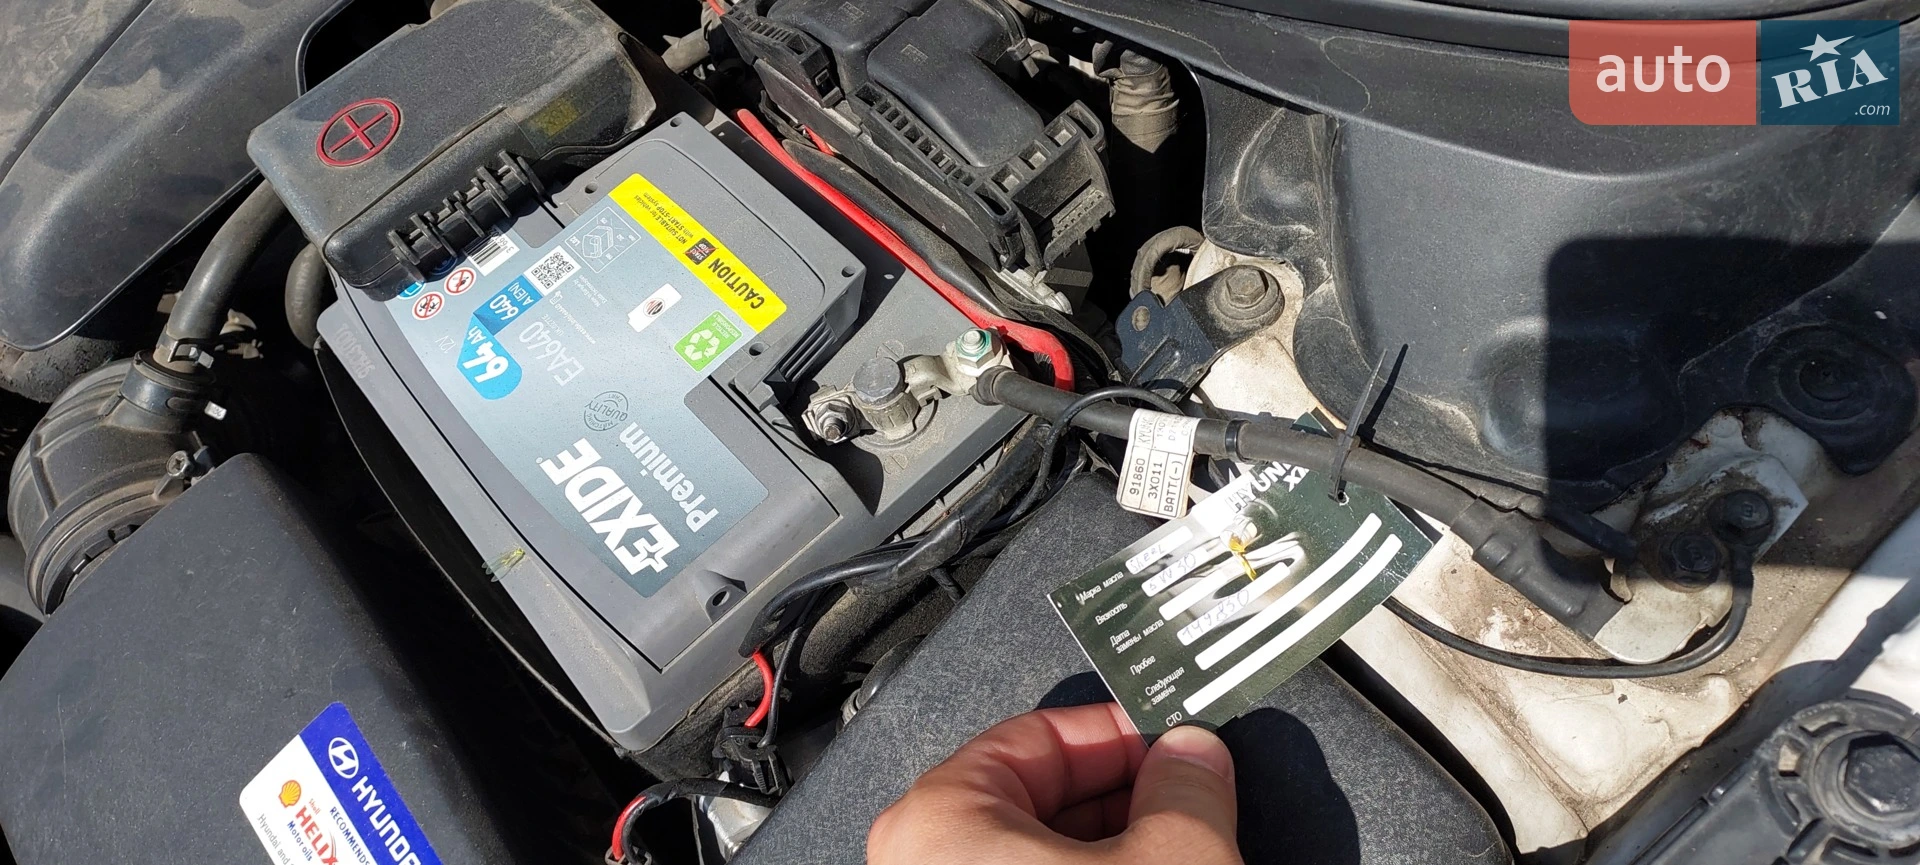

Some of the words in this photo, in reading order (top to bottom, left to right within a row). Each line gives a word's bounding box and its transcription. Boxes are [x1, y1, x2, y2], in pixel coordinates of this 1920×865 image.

[655, 215, 677, 237] SUITABLE
[676, 235, 688, 245] NOT
[707, 257, 765, 309] CAUTION
[489, 293, 519, 321] 640
[435, 325, 457, 354] 12V
[467, 325, 487, 345] Ah
[462, 341, 509, 384] 64
[519, 321, 585, 387] EA640
[584, 401, 628, 421] QUALITY
[608, 394, 623, 403] PART
[619, 422, 719, 533] Premium
[1129, 458, 1146, 496] 91860
[1148, 462, 1162, 499] 3X011
[1225, 461, 1292, 514] HYUN
[539, 438, 680, 575] EXIDE
[1103, 571, 1124, 588] масла
[1095, 602, 1128, 625] Вязкость
[1110, 629, 1130, 647] Дата
[1116, 633, 1142, 654] замены
[1142, 620, 1164, 636] масла
[1130, 655, 1156, 676] Пробег
[1145, 666, 1185, 696] Следующая
[1151, 685, 1176, 705] замена
[1165, 711, 1182, 727] СТО
[308, 798, 321, 815] Shell
[257, 813, 282, 851] Hyundai
[277, 848, 291, 865] and
[287, 820, 304, 848] Motor
[301, 847, 313, 862] oils
[295, 805, 340, 865] HELIX
